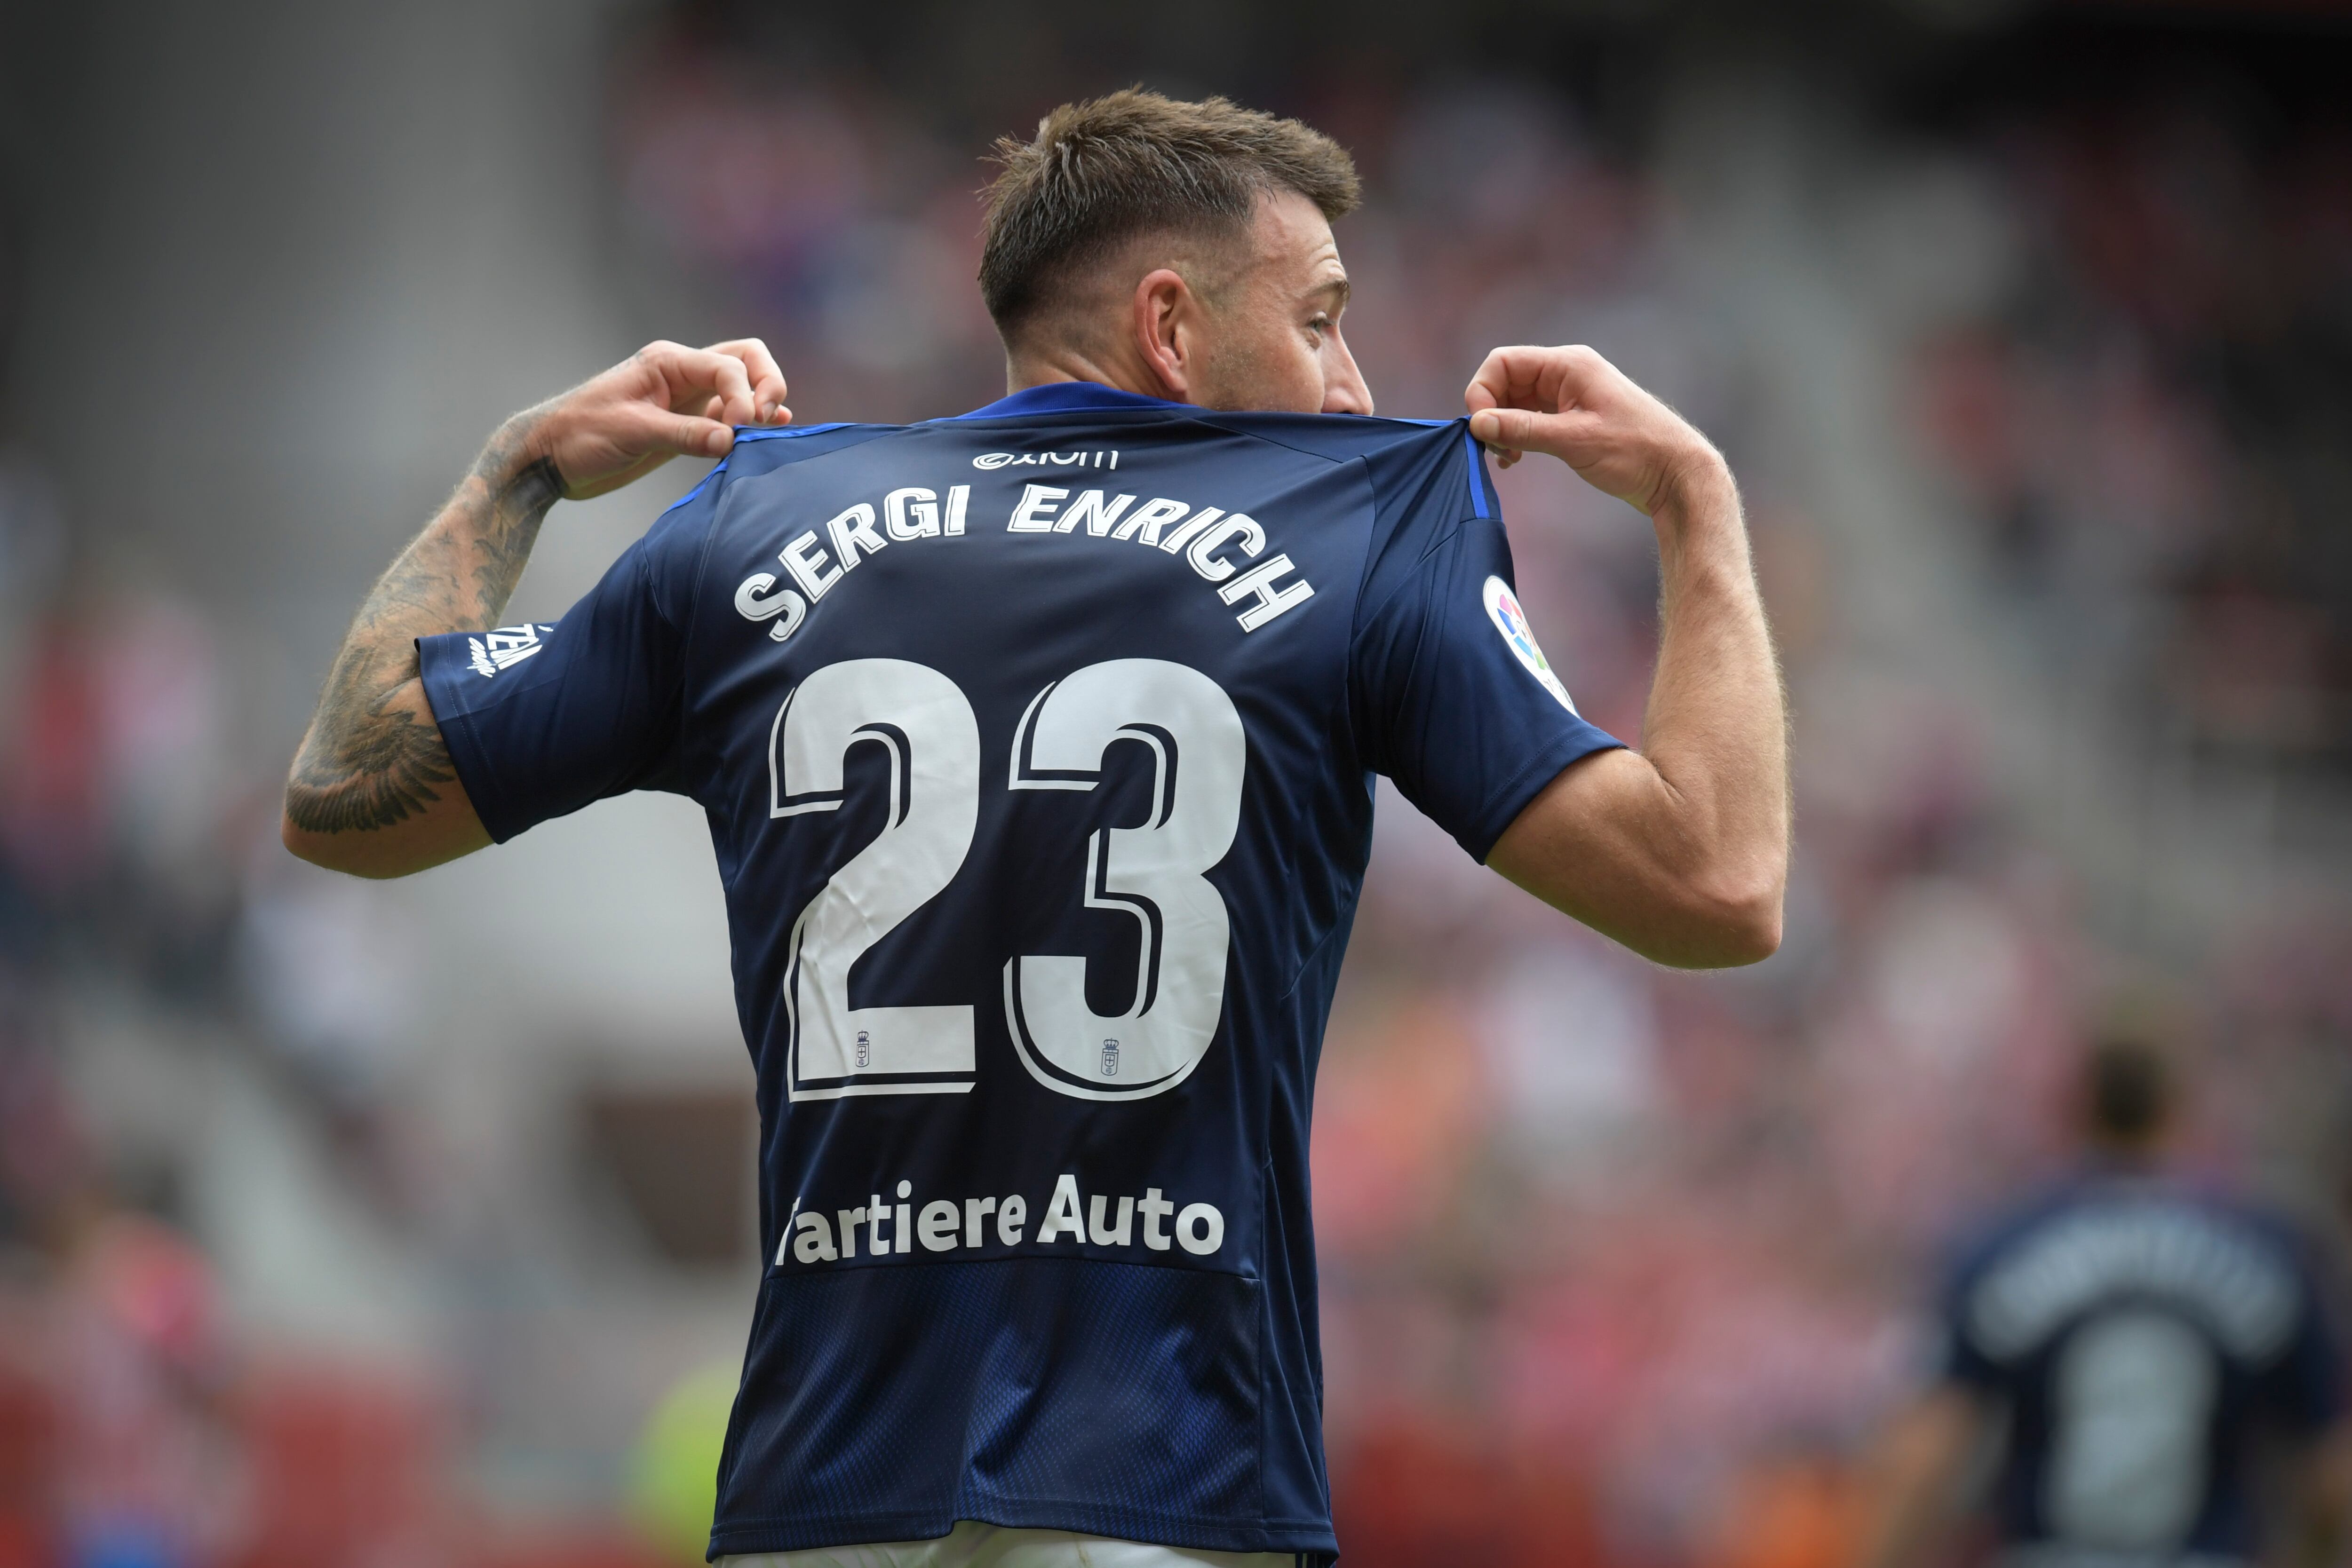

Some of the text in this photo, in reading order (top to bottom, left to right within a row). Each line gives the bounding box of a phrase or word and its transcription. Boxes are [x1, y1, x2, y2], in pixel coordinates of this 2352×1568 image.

[734, 483, 1315, 642] SERGI ENRICH
[769, 658, 1247, 1103] 23
[1036, 1174, 1224, 1255] Auto
